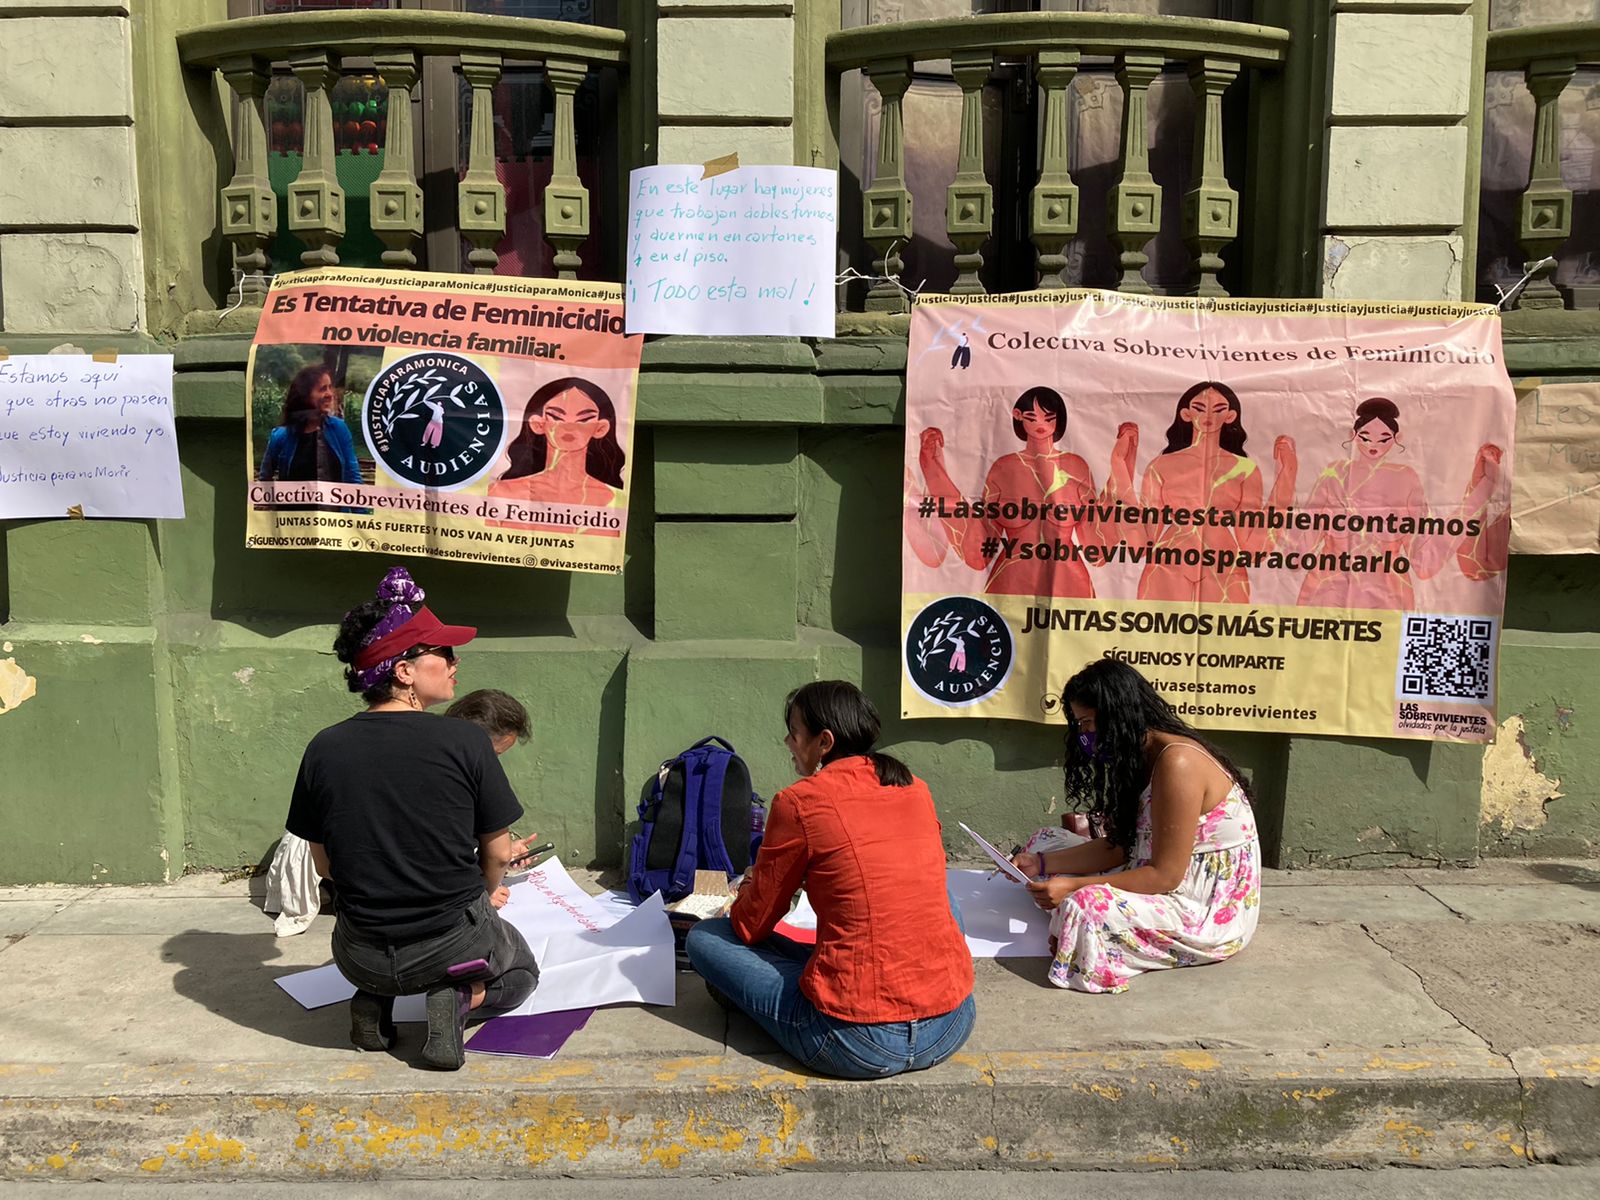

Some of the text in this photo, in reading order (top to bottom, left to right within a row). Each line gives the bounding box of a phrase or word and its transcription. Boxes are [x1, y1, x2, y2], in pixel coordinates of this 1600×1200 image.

[637, 176, 833, 203] En este lugar hay mujeres
[634, 202, 835, 229] que trabajan dobles turnos
[632, 226, 818, 255] y duermen en cartones
[649, 253, 669, 262] en
[673, 248, 689, 262] el
[693, 248, 729, 267] piso.
[707, 276, 747, 302] esta
[758, 278, 798, 300] mal
[271, 295, 298, 314] Es
[302, 292, 428, 318] Tentativa
[432, 298, 467, 321] de
[321, 323, 566, 361] no violencia familiar.
[987, 331, 1106, 352] Colectiva
[1113, 337, 1299, 363] Sobrevivientes
[1307, 346, 1337, 360] de
[6, 390, 168, 416] que otras no pasen
[371, 357, 469, 454] #JUSTICIAPARAMONICA
[0, 431, 19, 440] ue
[79, 424, 137, 440] viviendo
[401, 380, 492, 476] AUDIENCIAS
[250, 486, 621, 530] Colectiva Sobrevivientes de Feminicidio
[918, 496, 1482, 537] #Lassobrevivientestambiencontamos
[275, 517, 575, 549] JUNTAS SOMOS MÁS FUERTES Y NOS VAN A VER JUNTAS
[248, 534, 622, 573] SÍGUENOS Y COMPARTE @colectivadesobrevivientes @vivasestamos
[980, 537, 1411, 575] #Ysobrevivimosparacontarlo
[1021, 606, 1383, 643] JUNTAS SOMOS MÁS FUERTES
[934, 615, 1002, 694] AUDIENCIAS
[1103, 646, 1286, 671] SÍGUENOS Y COMPARTE
[1150, 678, 1257, 695] ivasestamos
[1398, 711, 1487, 726] SOBREVIVIENTES
[1399, 702, 1419, 712] LAS
[1398, 720, 1486, 737] olvidadas por la justicia
